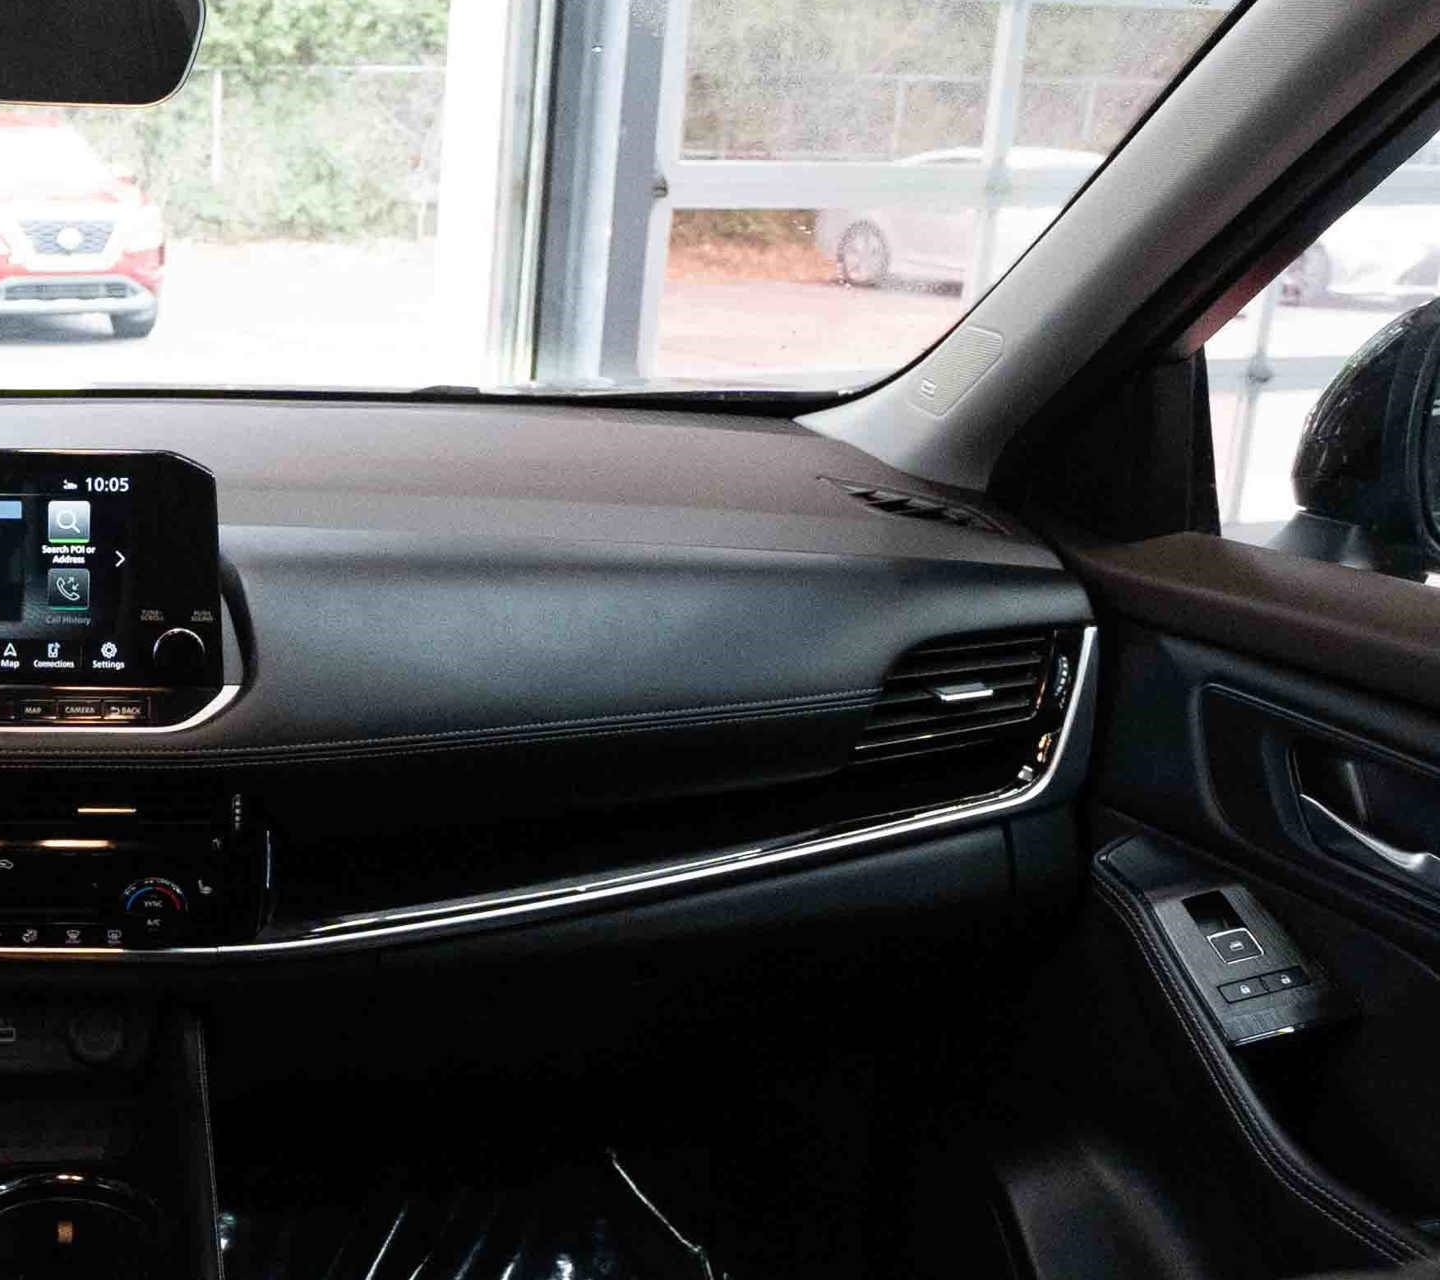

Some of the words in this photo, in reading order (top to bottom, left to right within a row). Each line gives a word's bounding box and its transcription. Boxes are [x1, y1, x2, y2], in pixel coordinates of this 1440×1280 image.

[85, 477, 129, 492] 10:05
[42, 545, 69, 554] Search
[52, 555, 85, 564] Address
[46, 616, 62, 624] Call
[63, 616, 91, 626] History
[0, 659, 20, 669] Map
[33, 659, 75, 668] Connections
[92, 660, 125, 670] Settings
[25, 706, 41, 714] MAP
[65, 706, 95, 714] CAMERA
[121, 706, 142, 714] BACK
